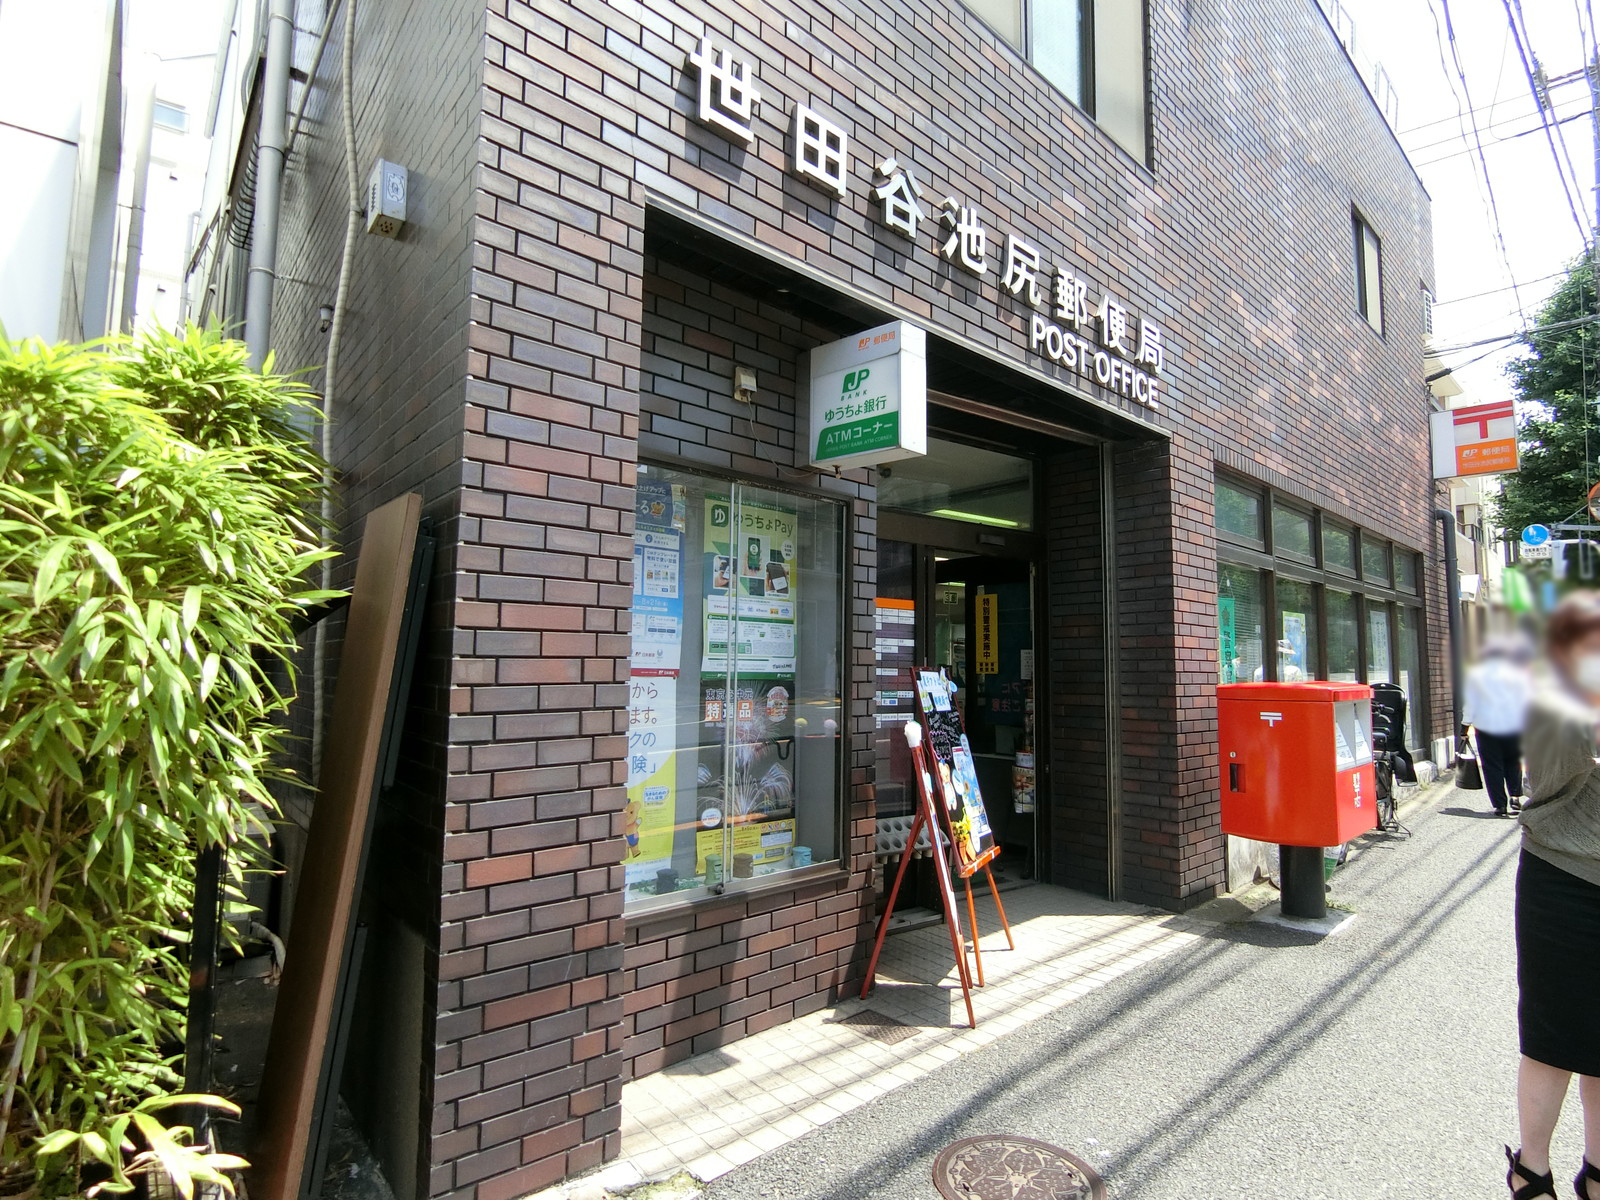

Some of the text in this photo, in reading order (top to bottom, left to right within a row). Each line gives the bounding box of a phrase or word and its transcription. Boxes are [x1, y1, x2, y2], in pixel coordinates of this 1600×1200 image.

[689, 35, 1164, 375] 世田谷池尻郵便局
[1029, 313, 1160, 410] POST OFFICE
[841, 368, 870, 394] JP
[840, 389, 868, 402] BANK
[824, 395, 887, 423] ゆうちょ銀行
[825, 421, 894, 446] ATMコーナー
[733, 511, 795, 538] ゆうちょPay
[982, 597, 992, 660] 特別警戒実施中
[631, 682, 659, 699] から
[629, 705, 658, 725] ます。
[629, 731, 657, 749] クの
[631, 755, 657, 775] 険」
